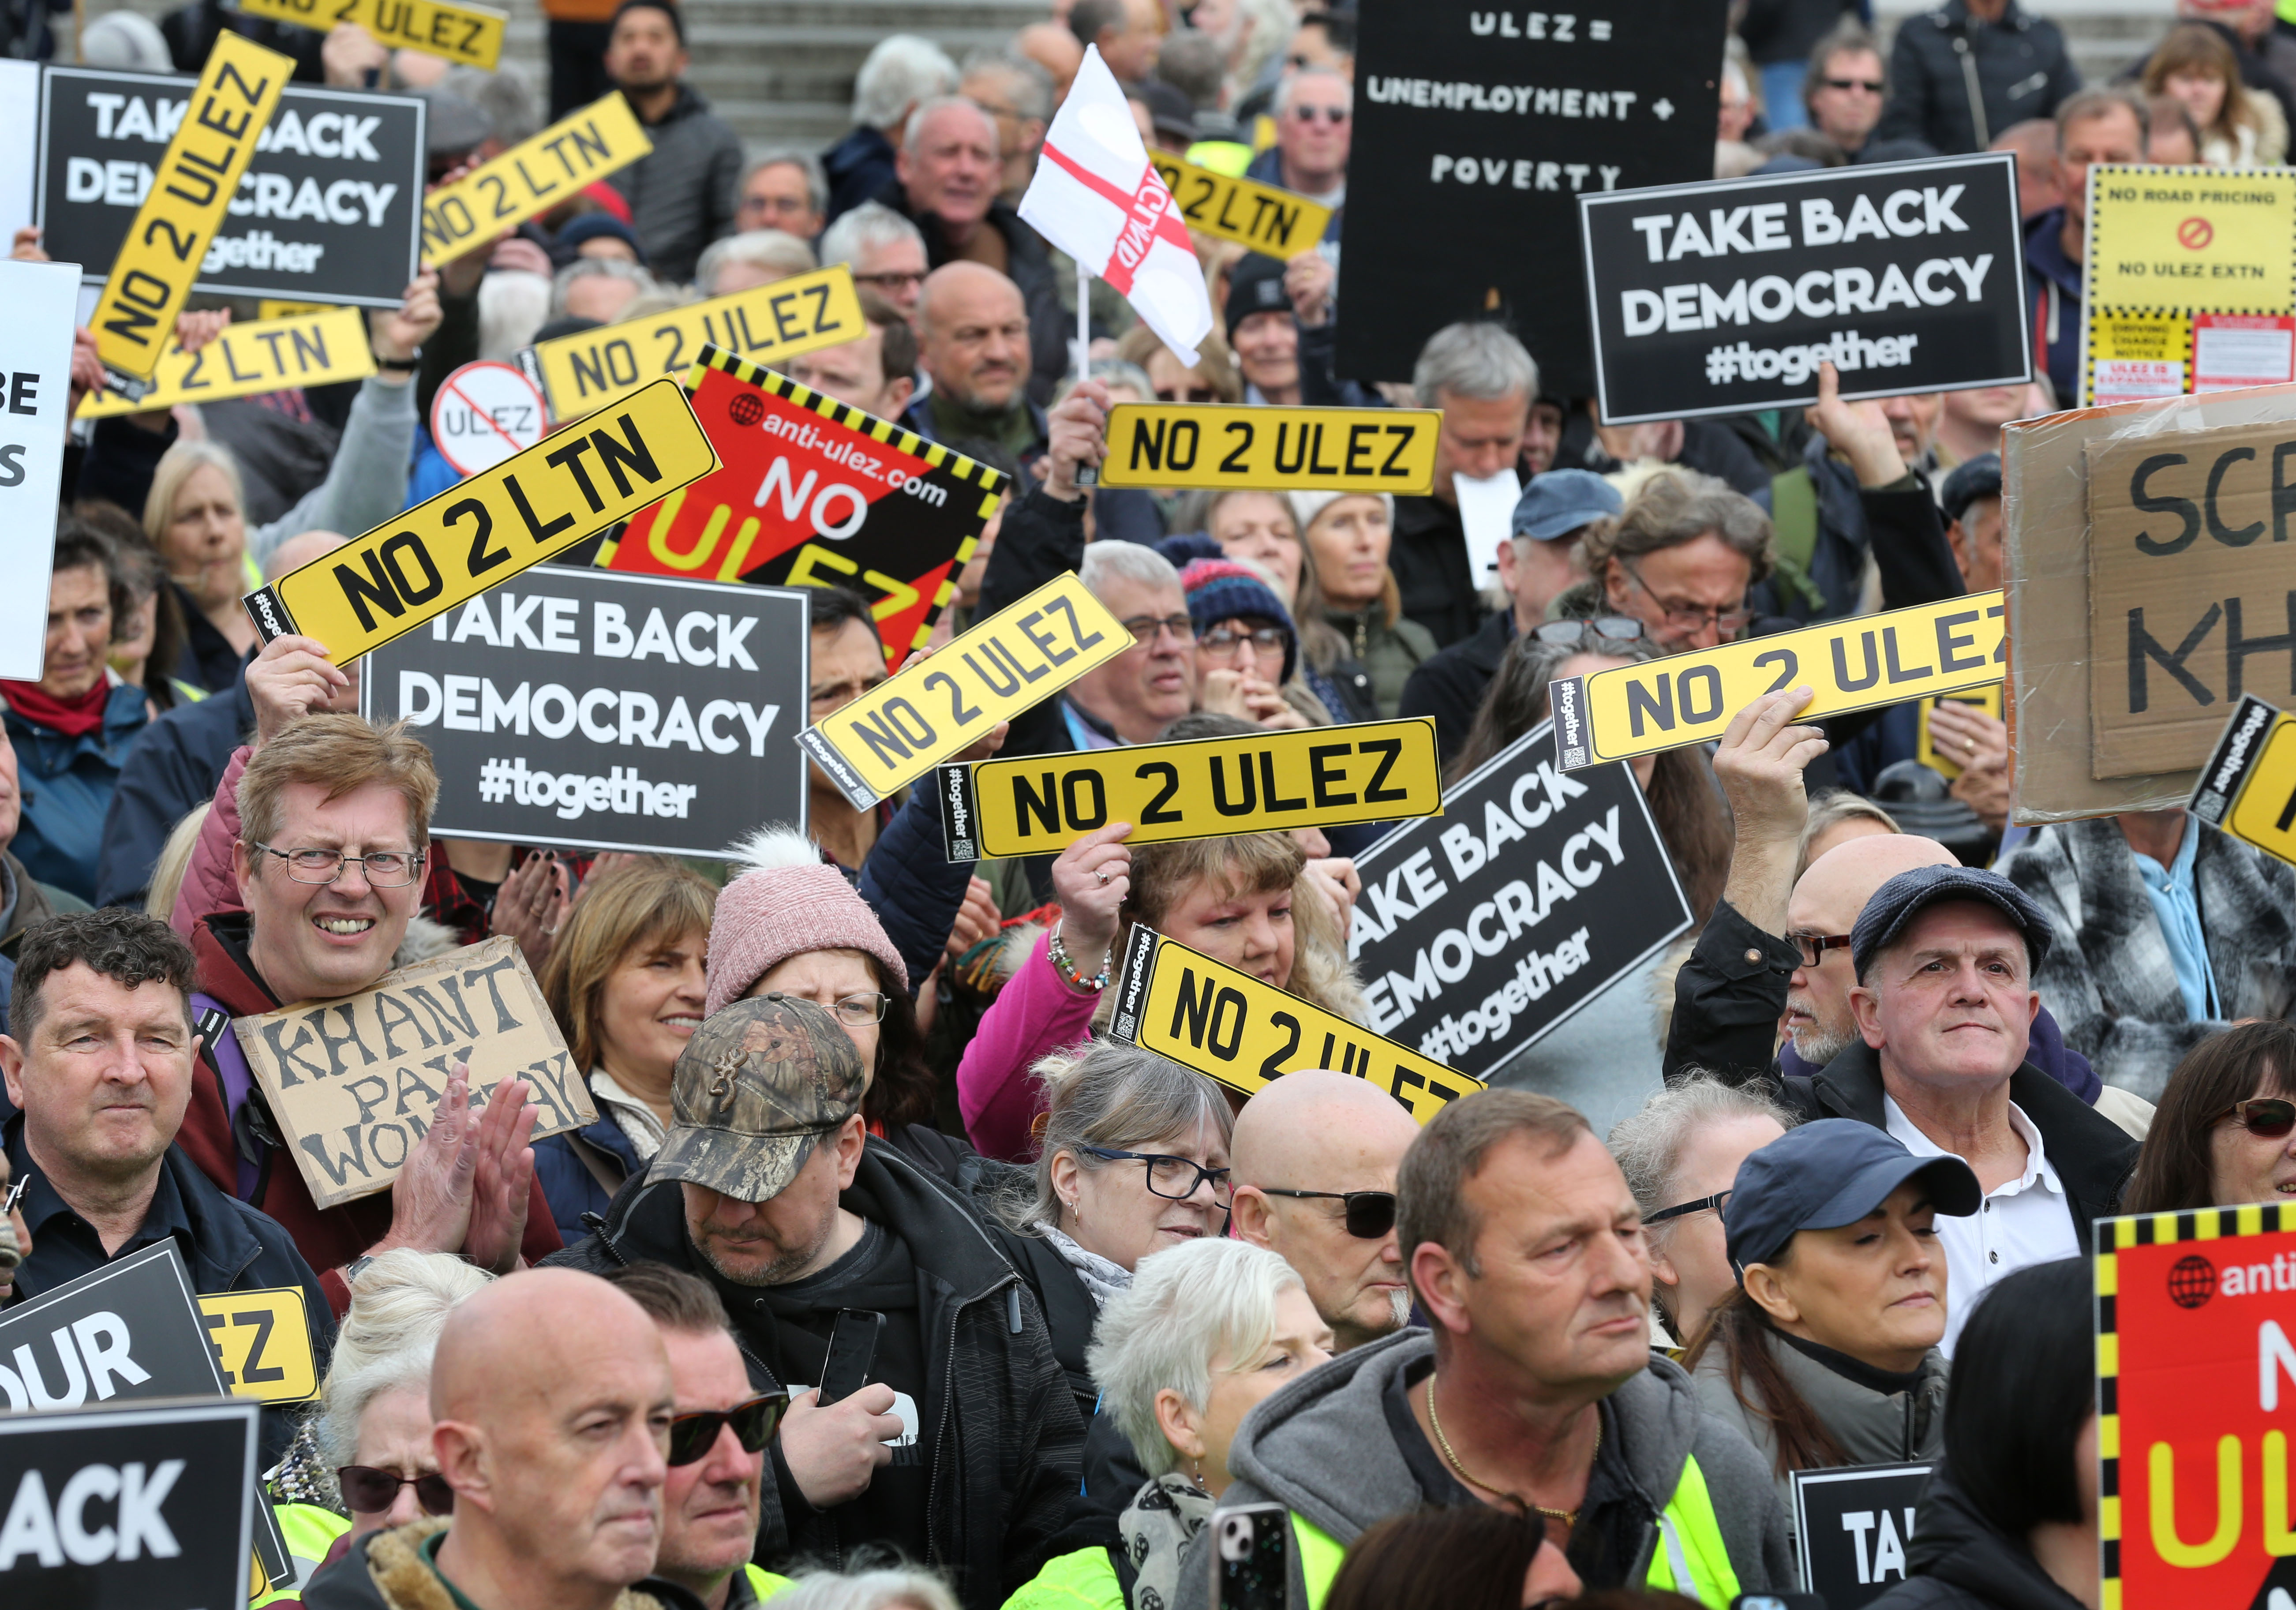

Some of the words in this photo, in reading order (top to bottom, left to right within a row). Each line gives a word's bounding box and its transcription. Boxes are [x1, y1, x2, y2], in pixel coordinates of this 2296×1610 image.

[375, 0, 483, 56] ULEZ
[1470, 11, 1577, 43] ULEZ
[1590, 20, 1613, 41] =
[86, 92, 190, 144] TAK
[165, 61, 269, 208] ULEZ
[1367, 75, 1637, 120] UNEMPLOYMENT
[477, 176, 518, 219] 2
[515, 120, 612, 198] LTN
[1431, 154, 1622, 191] POVERTY
[2109, 187, 2137, 201] NO
[2145, 189, 2194, 204] ROAD
[2200, 190, 2276, 205] PRICING
[144, 217, 197, 262] 2
[1184, 177, 1215, 220] 2
[1217, 186, 1301, 247] LTN
[1632, 202, 1792, 263] TAKE
[1800, 183, 1970, 247] BACK
[201, 229, 323, 274] gether
[2118, 262, 2146, 276] NO
[2154, 262, 2205, 278] ULEZ
[2212, 264, 2265, 278] EXTN
[103, 269, 171, 347] NO
[1621, 253, 1994, 337] DEMOCRACY
[171, 344, 210, 392] 2
[221, 324, 332, 383] LTN
[569, 339, 639, 397] NO
[654, 326, 691, 374] 2
[702, 283, 842, 355] ULEZ
[1705, 329, 1918, 386] #together
[0, 372, 40, 416] E
[445, 405, 534, 437] ULEZ
[762, 413, 948, 508] anti-ulez.com
[1129, 418, 1199, 472] NO
[1218, 421, 1255, 473] 2
[1274, 423, 1416, 477] ULEZ
[332, 531, 443, 633] NO
[442, 498, 512, 578] 2
[502, 412, 663, 545] LTN
[754, 456, 868, 540] NO
[593, 600, 759, 672] BACK
[398, 670, 780, 758] DEMOCRACY
[850, 696, 937, 771] NO
[924, 671, 983, 727] 2
[961, 594, 1105, 698] ULEZ
[1561, 681, 1579, 747] #together
[1626, 664, 1724, 738] NO
[1753, 649, 1798, 696] 2
[804, 732, 858, 789] #together
[2213, 704, 2268, 794] #together
[478, 756, 697, 820] #together
[948, 768, 969, 838] #together
[1011, 768, 1108, 837] NO
[1135, 761, 1183, 825] 2
[1209, 738, 1408, 817] ULEZ
[1347, 846, 1448, 962] AKE
[1439, 759, 1589, 883] BACK
[1363, 805, 1626, 1037] EMOCRACY
[1126, 932, 1152, 1013] #together
[1418, 926, 1590, 1066] #together
[262, 955, 524, 1090] KHANT
[1170, 967, 1248, 1062] NO
[1259, 1011, 1301, 1081] 2
